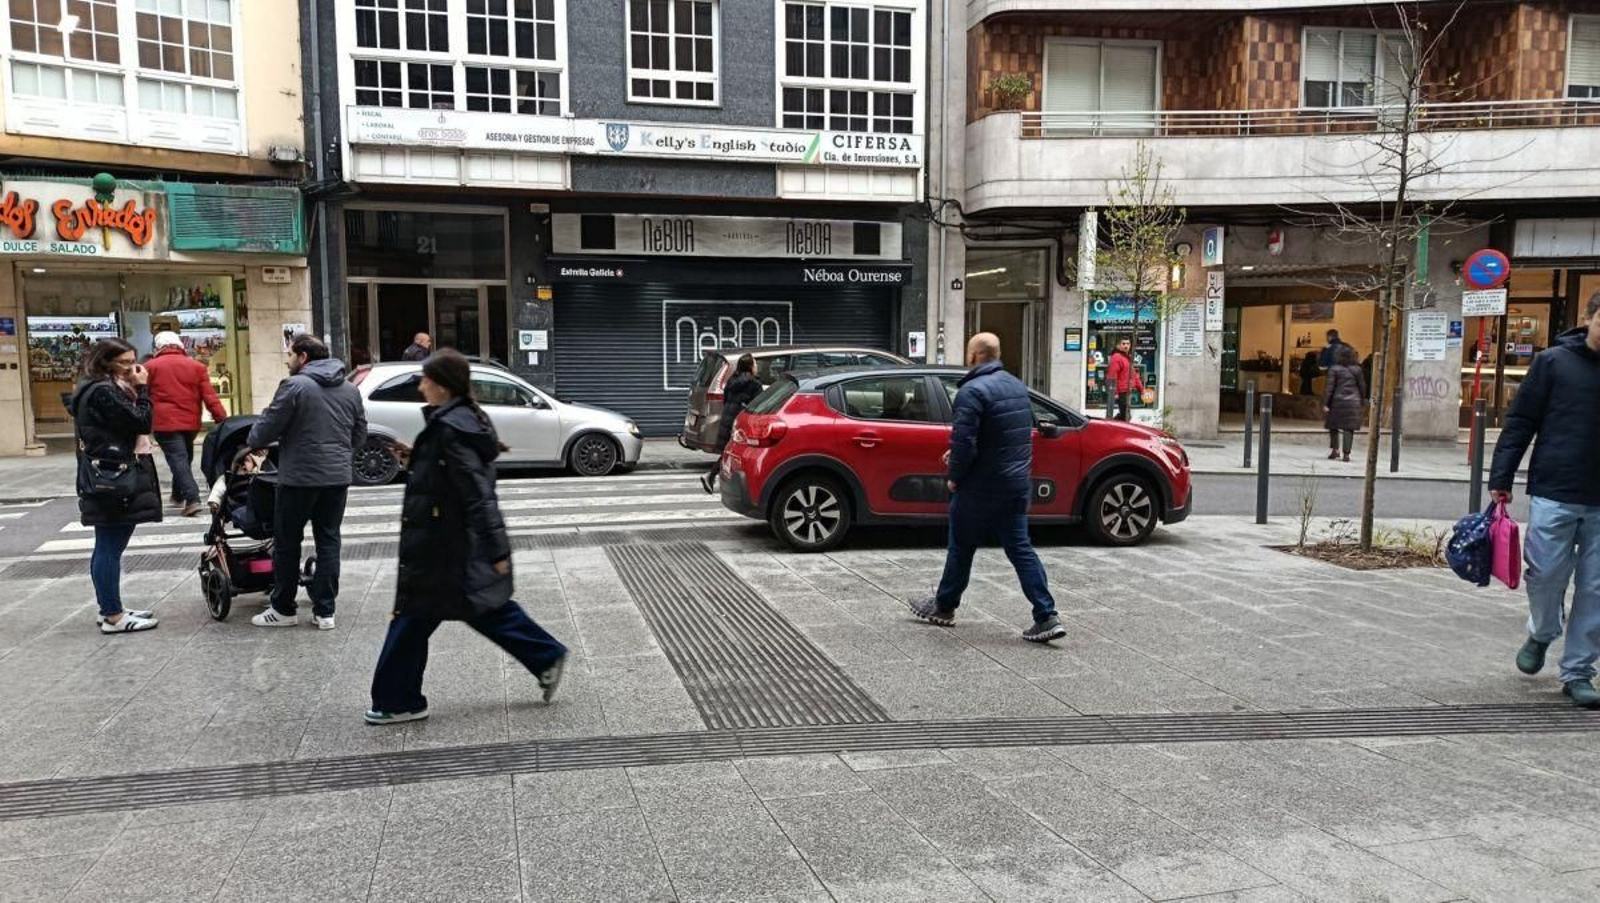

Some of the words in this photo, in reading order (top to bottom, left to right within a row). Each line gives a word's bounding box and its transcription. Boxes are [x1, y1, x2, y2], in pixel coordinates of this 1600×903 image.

[485, 132, 517, 142] ASESORIA
[551, 136, 561, 145] DE
[640, 131, 696, 150] Kelly's
[700, 134, 756, 152] English
[760, 137, 806, 153] Studio
[832, 134, 912, 150] CIFERSA
[842, 153, 851, 162] de
[3, 242, 38, 252] DULCE
[50, 243, 97, 255] SALADO
[416, 236, 438, 254] 21
[561, 267, 589, 277] Estrella
[589, 267, 616, 277] Galicia
[804, 268, 845, 282] Néboa
[848, 268, 902, 282] Ourense
